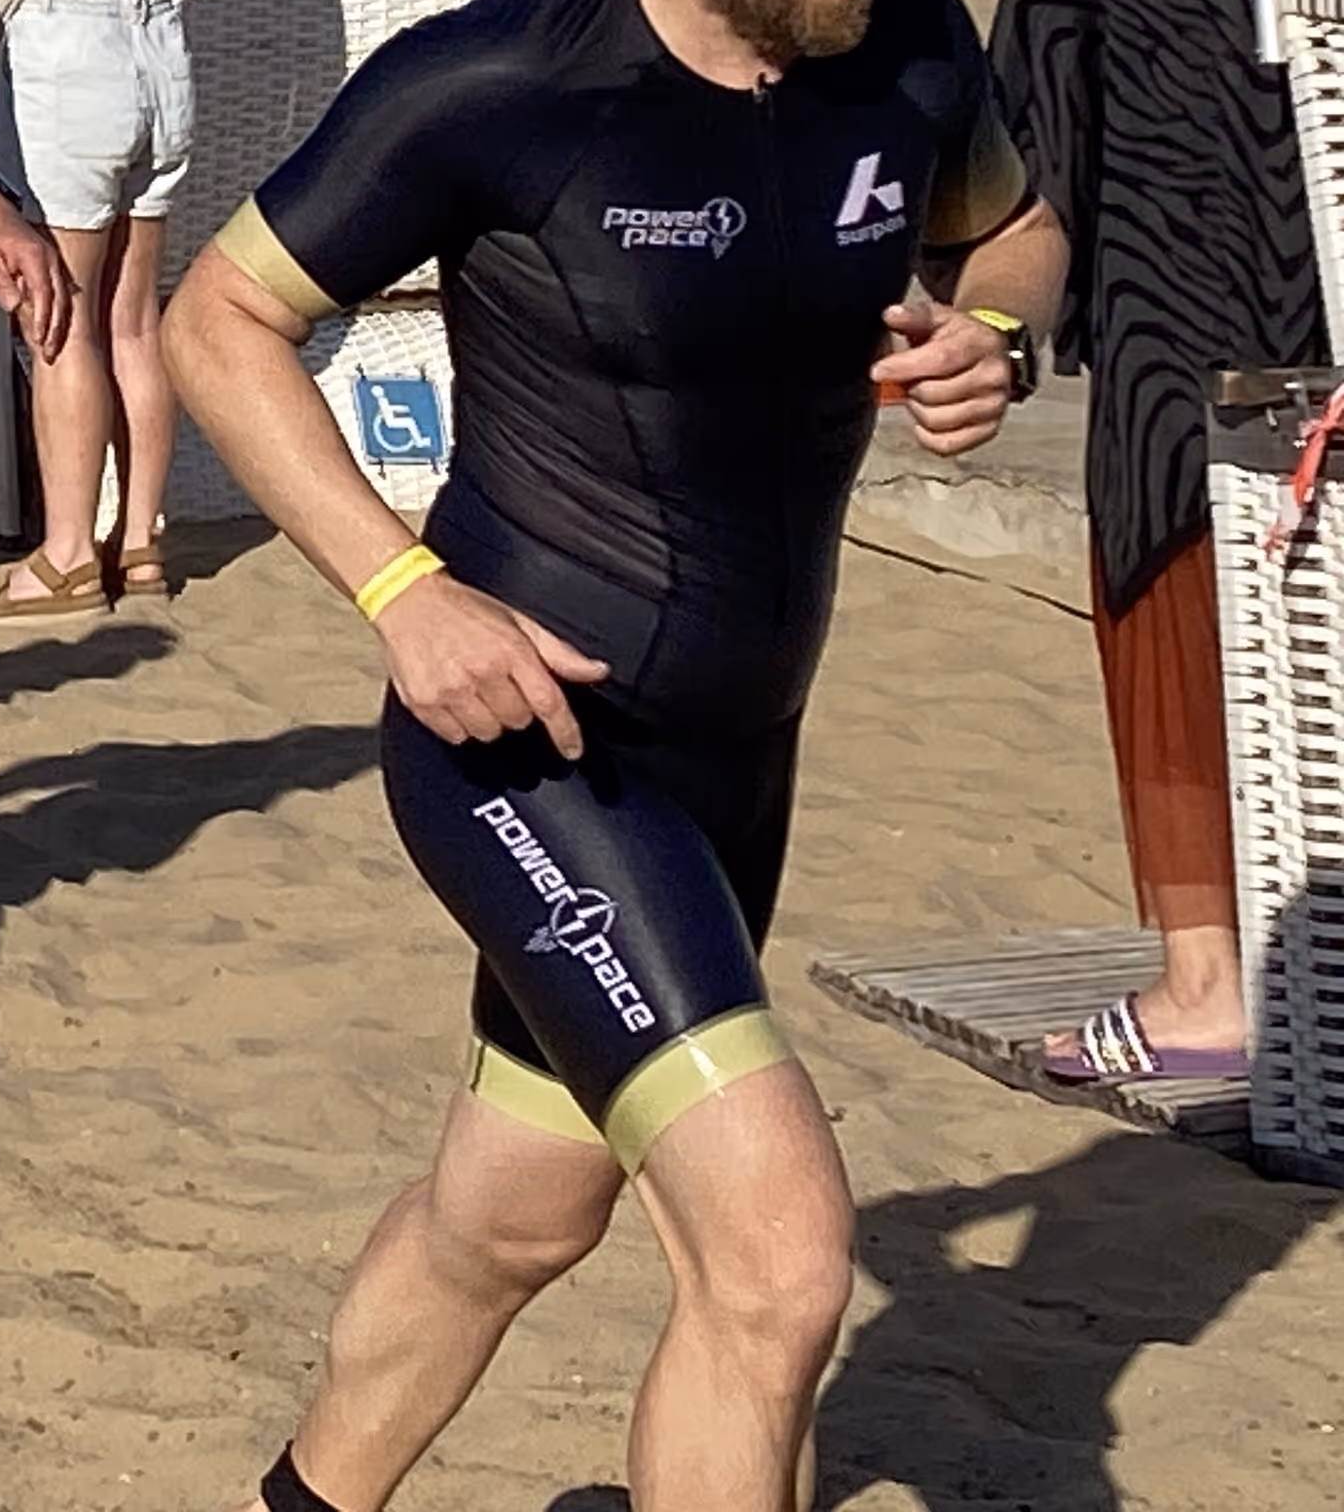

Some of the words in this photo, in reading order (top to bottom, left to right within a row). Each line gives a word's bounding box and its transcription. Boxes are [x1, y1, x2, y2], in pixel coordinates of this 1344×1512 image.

[602, 206, 710, 230] power
[621, 227, 708, 249] pace
[472, 796, 579, 905] power
[571, 933, 656, 1033] pace
